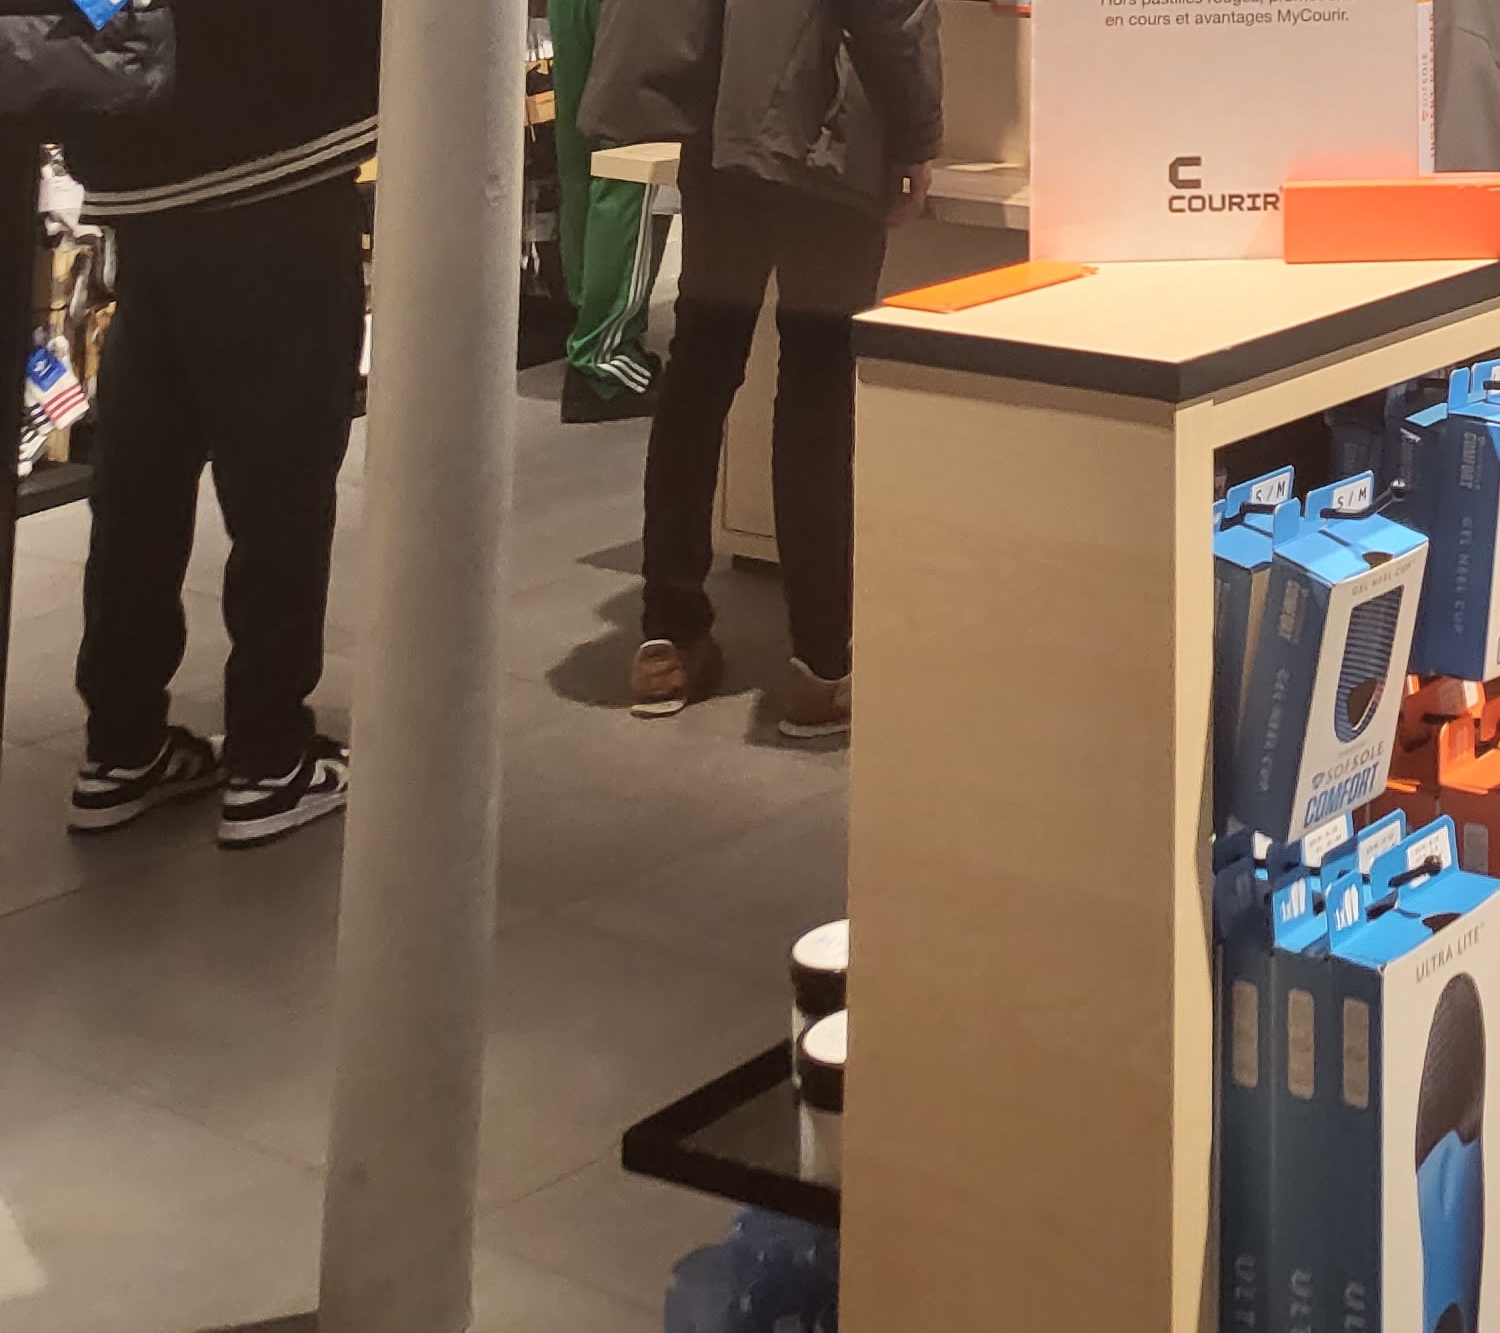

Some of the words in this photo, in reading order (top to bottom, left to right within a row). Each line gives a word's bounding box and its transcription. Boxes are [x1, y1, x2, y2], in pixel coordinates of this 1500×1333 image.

[1105, 15, 1124, 26] en
[1128, 13, 1171, 26] cours
[1175, 12, 1190, 25] et
[1195, 10, 1272, 27] avantages
[1277, 8, 1349, 26] MyCourir.
[1168, 193, 1281, 213] COURIR
[1304, 761, 1379, 829] COMFORT
[1416, 944, 1453, 983] ULTRA
